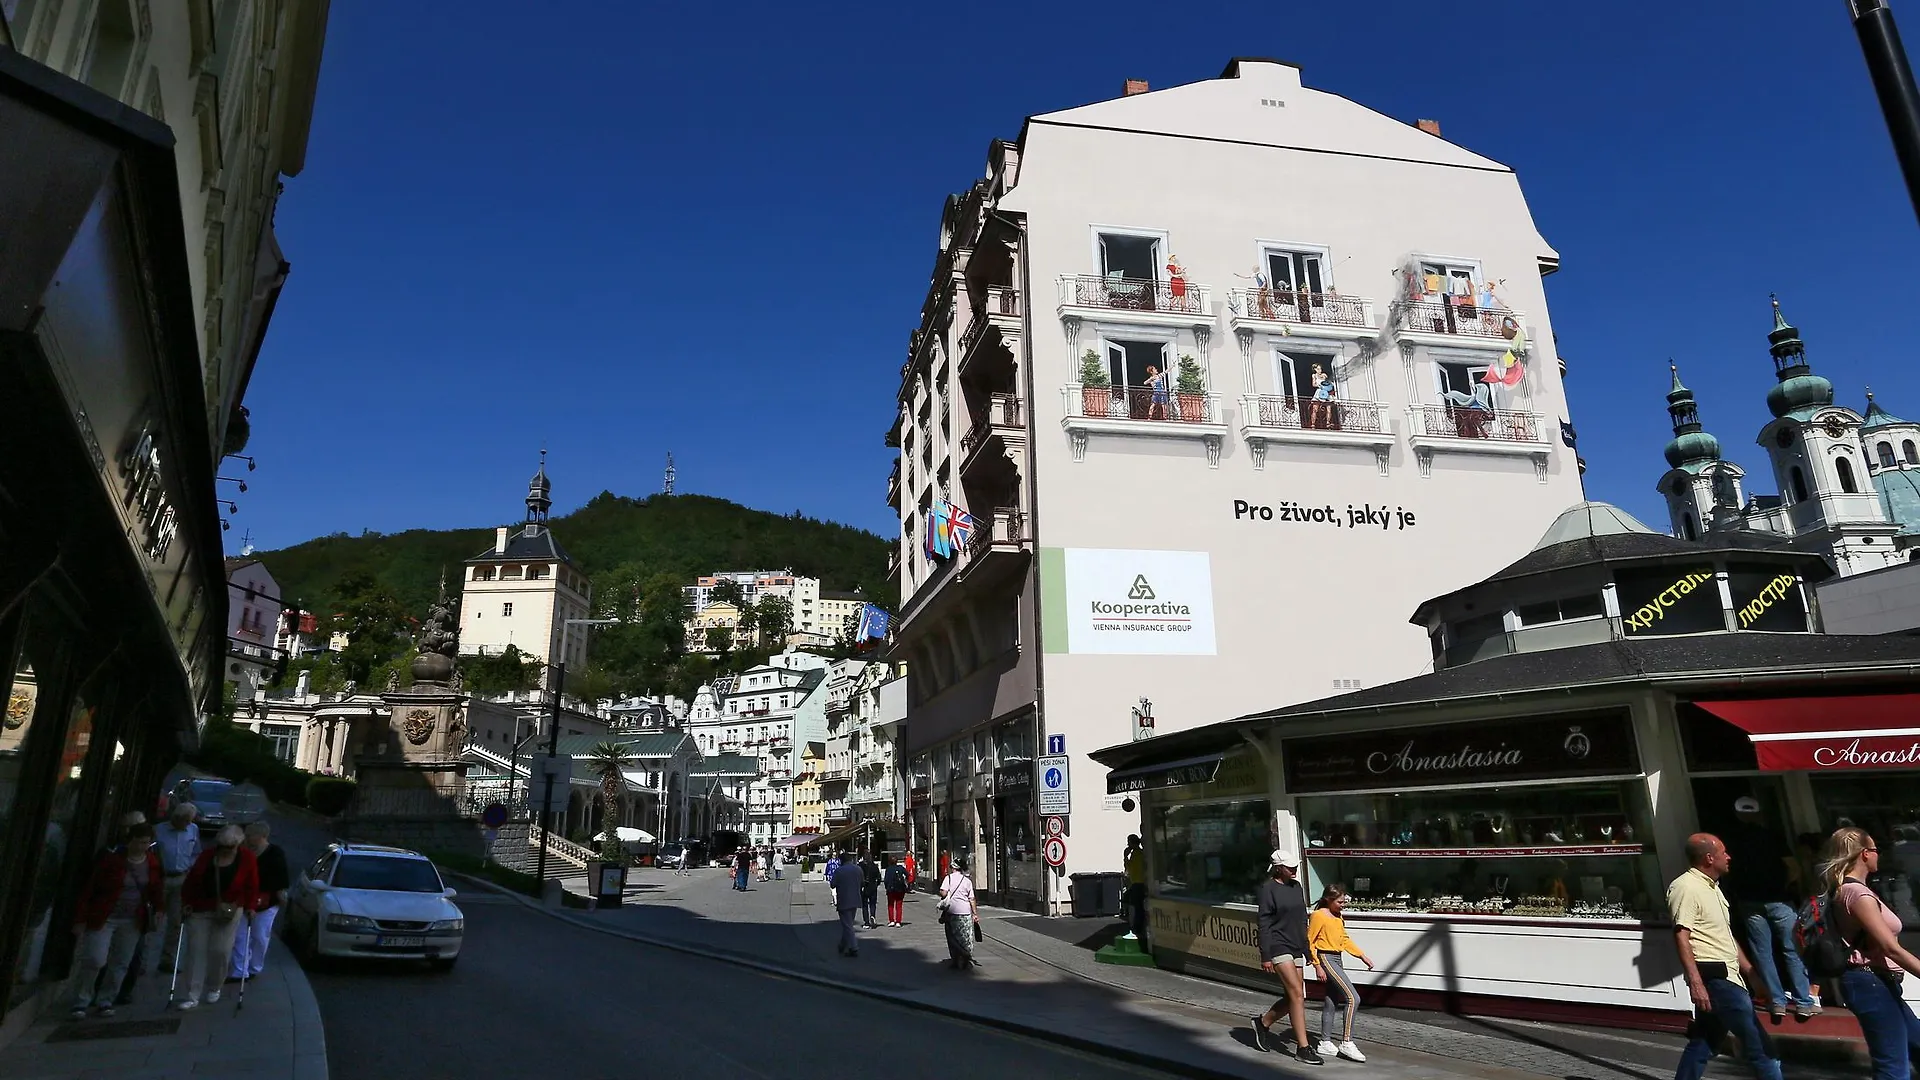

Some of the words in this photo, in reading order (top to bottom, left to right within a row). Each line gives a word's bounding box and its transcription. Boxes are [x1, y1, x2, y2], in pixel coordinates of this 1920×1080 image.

[1233, 499, 1273, 521] Pro
[1279, 501, 1342, 527] život,
[1346, 503, 1391, 531] jaký
[1396, 506, 1416, 530] je
[1091, 600, 1191, 617] Kooperativa
[1624, 567, 1714, 633] хрусталь
[1737, 571, 1798, 629] люстры
[1092, 623, 1121, 632] VIENNA
[1122, 623, 1165, 632] INSURANCE
[1167, 624, 1192, 632] GROUP
[1366, 739, 1524, 774] Anastasia
[1813, 738, 1920, 766] Anast
[1153, 907, 1172, 930] The
[1175, 911, 1195, 936] Art
[1196, 914, 1209, 938] of
[1210, 915, 1260, 948] Chocola
